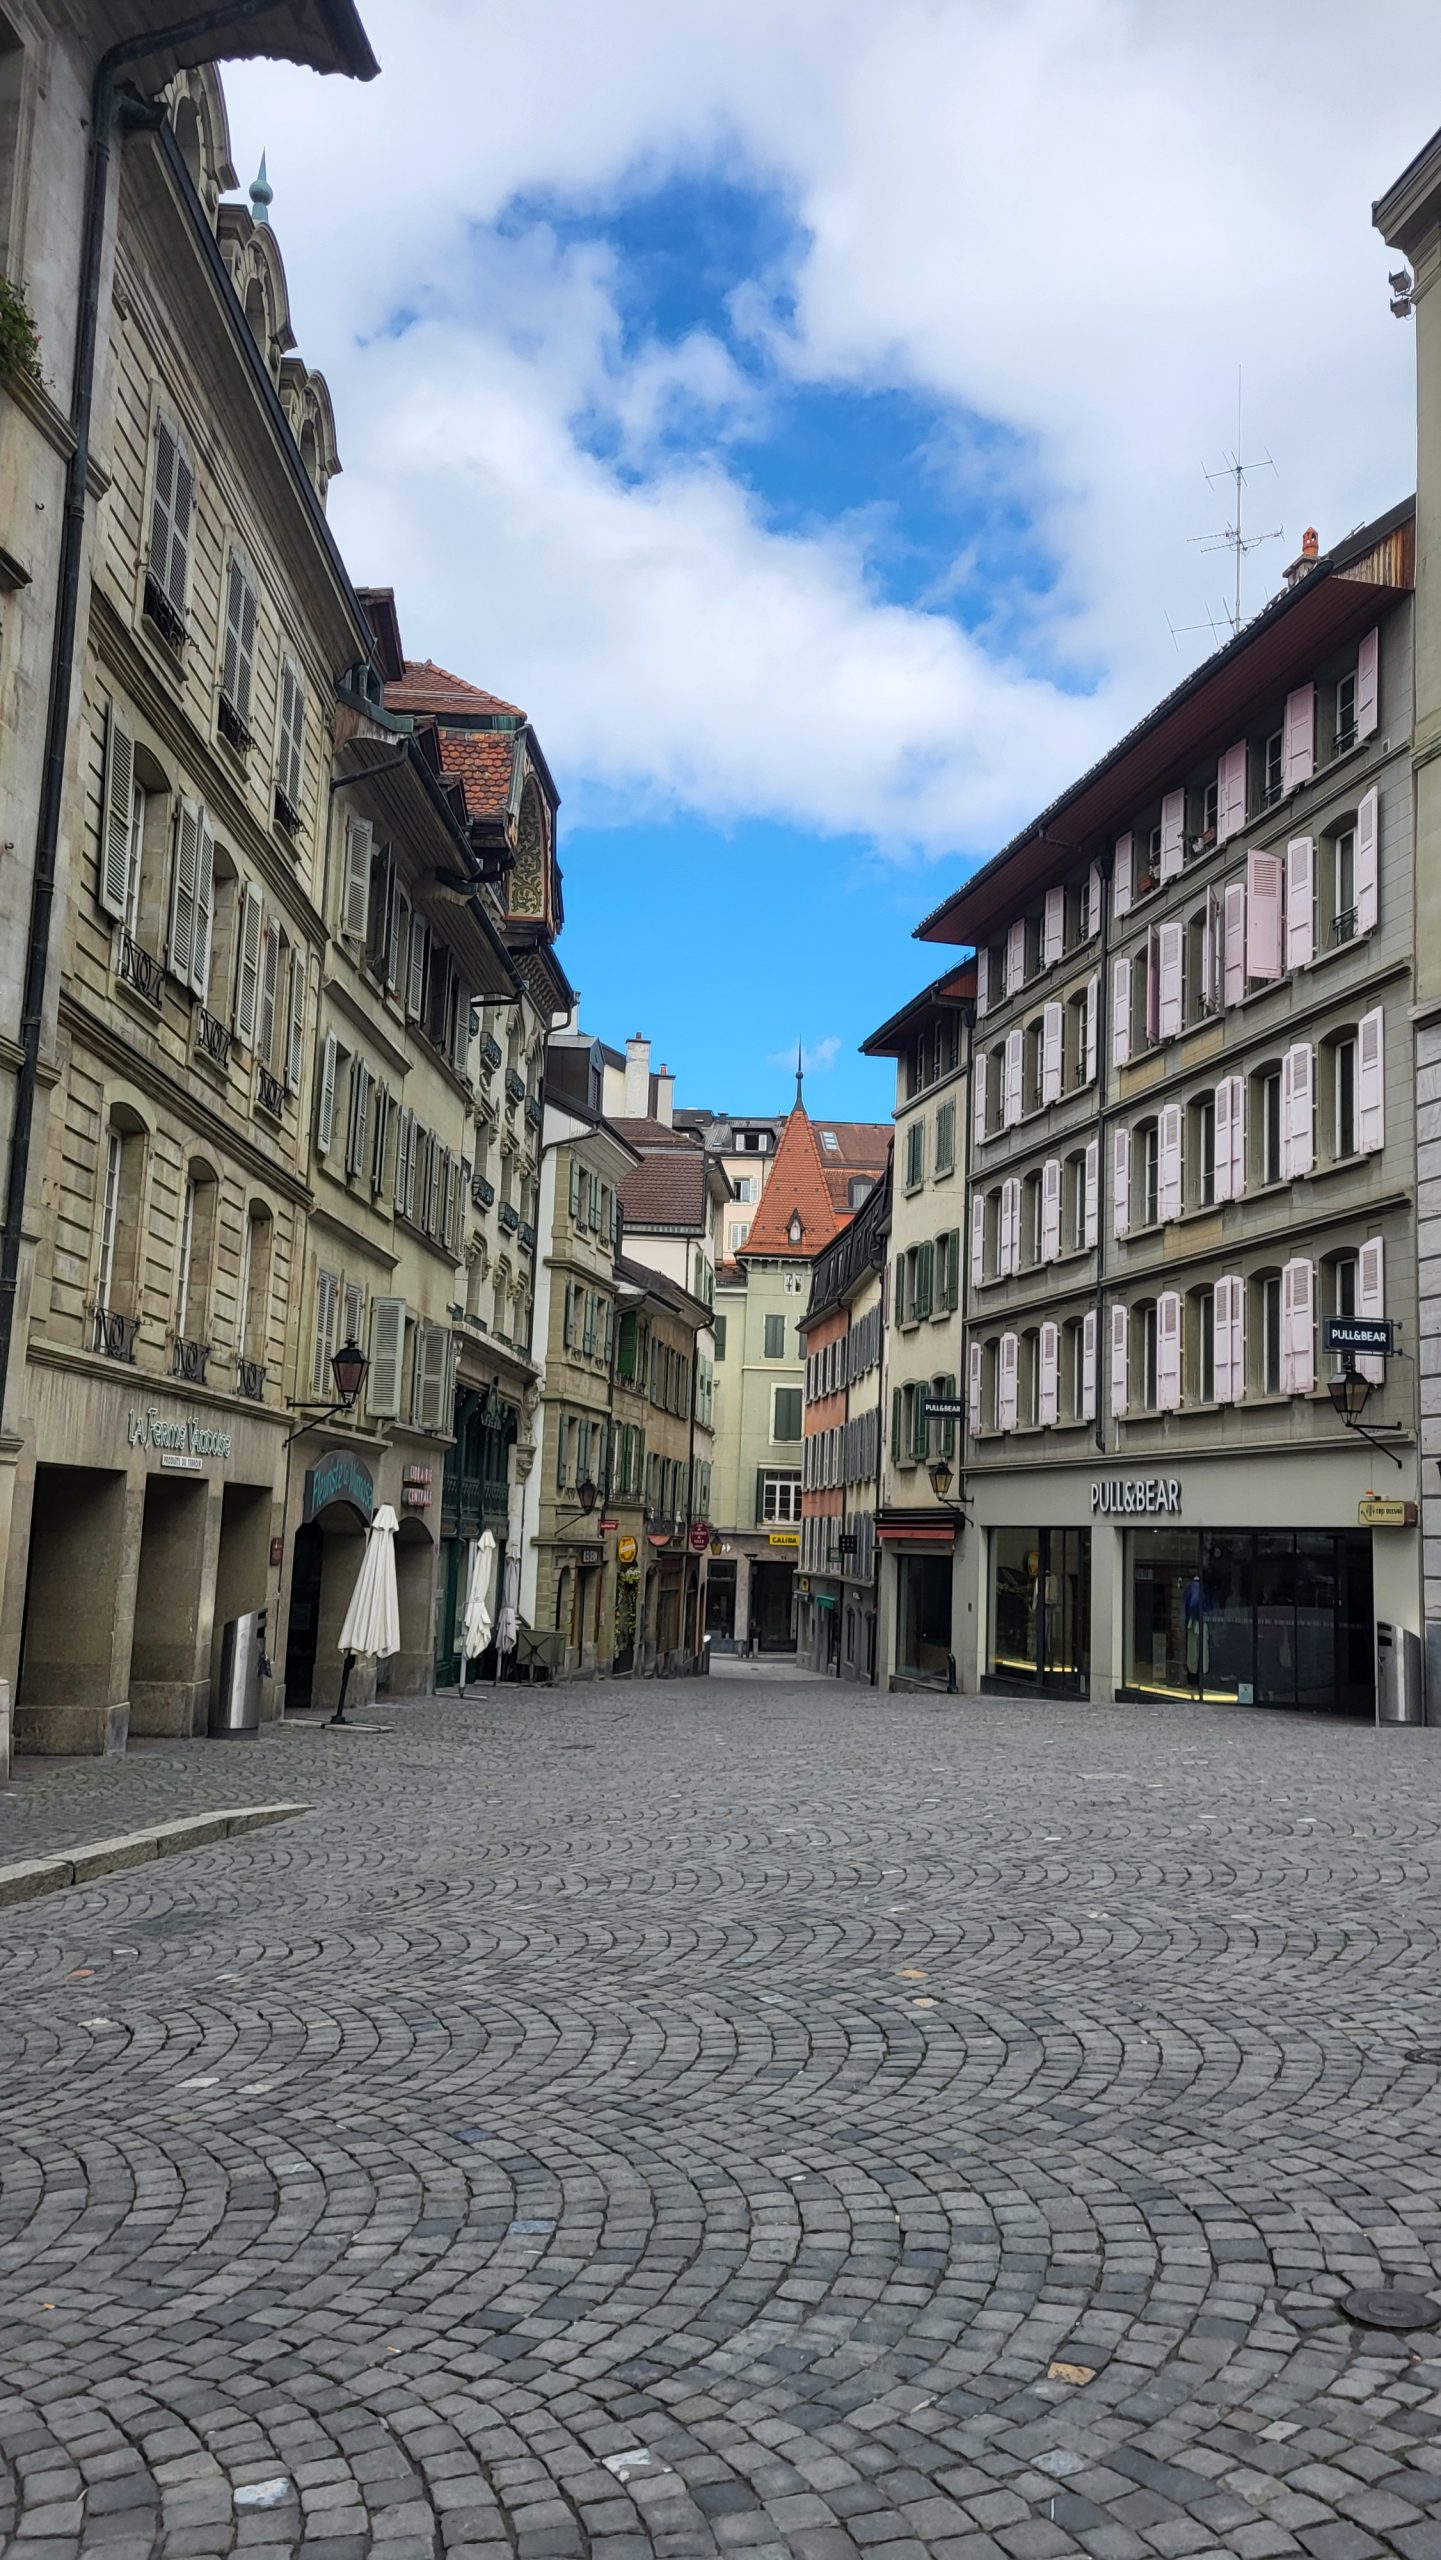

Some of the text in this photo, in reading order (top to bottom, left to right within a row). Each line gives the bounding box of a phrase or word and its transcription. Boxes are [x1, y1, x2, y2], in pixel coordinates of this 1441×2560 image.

[1331, 1329, 1387, 1343] PULL&BEAR
[925, 1403, 961, 1413] PULL&BEAR
[1090, 1479, 1180, 1514] PULL&BEAR
